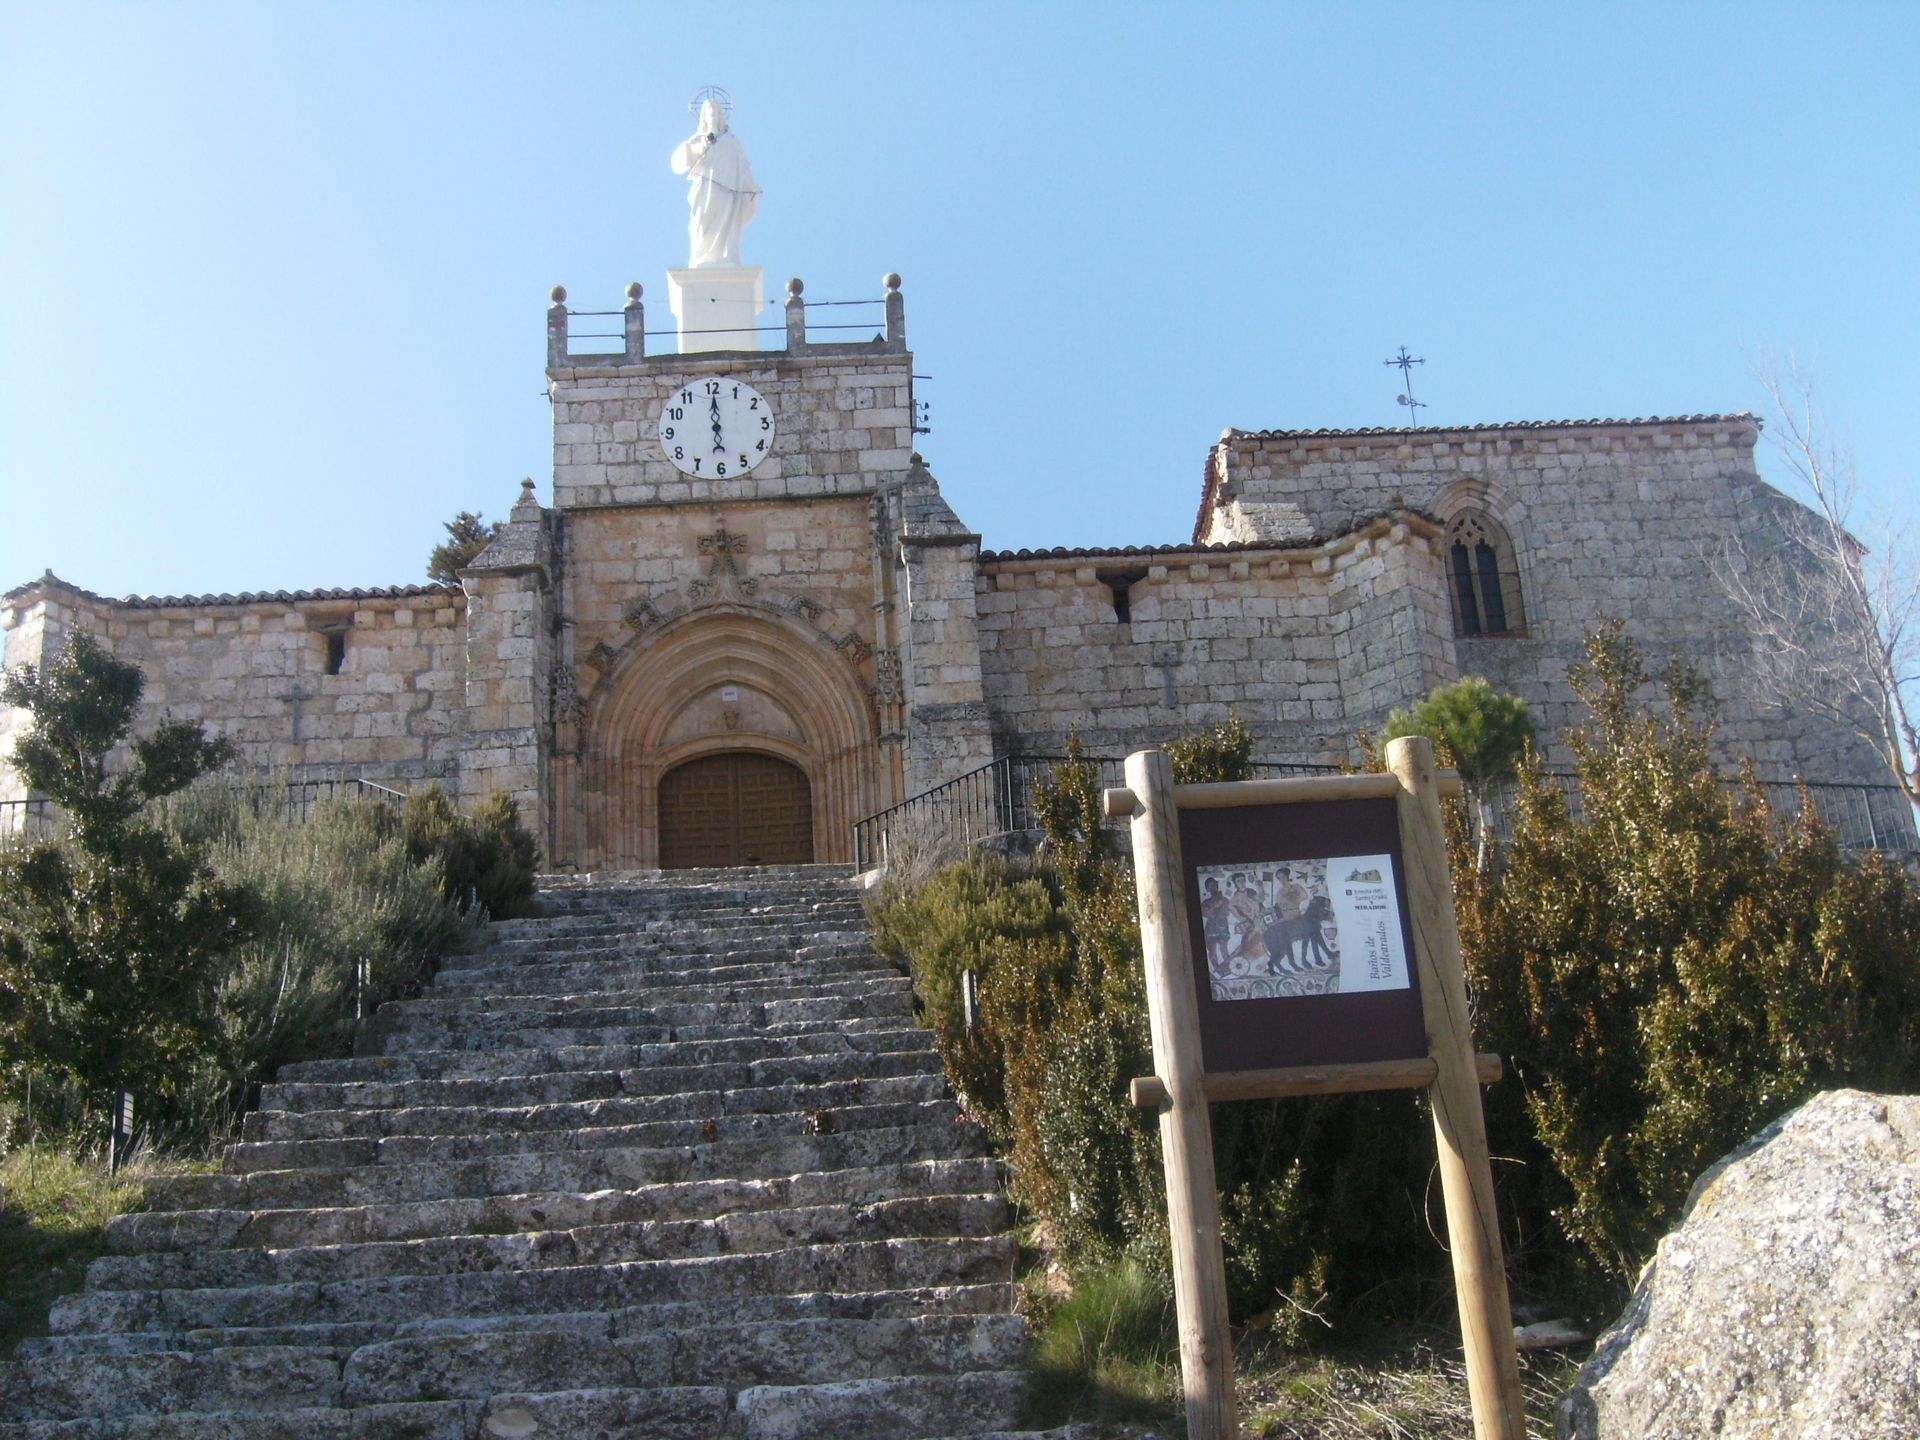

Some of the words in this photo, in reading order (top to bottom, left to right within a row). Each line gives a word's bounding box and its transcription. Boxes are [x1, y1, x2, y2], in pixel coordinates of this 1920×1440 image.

[705, 382, 720, 395] 12
[732, 387, 738, 399] 1
[681, 392, 693, 404] 11
[750, 398, 758, 410] 2
[669, 408, 683, 420] 10
[761, 417, 770, 430] 3
[665, 428, 675, 440] 9
[756, 439, 764, 452] 4
[674, 446, 684, 460] 8
[694, 458, 702, 471] 7
[740, 455, 748, 468] 5
[717, 462, 726, 475] 6
[1365, 936, 1376, 947] de
[1376, 920, 1392, 979] Valdearados
[1368, 949, 1380, 980] Baños
